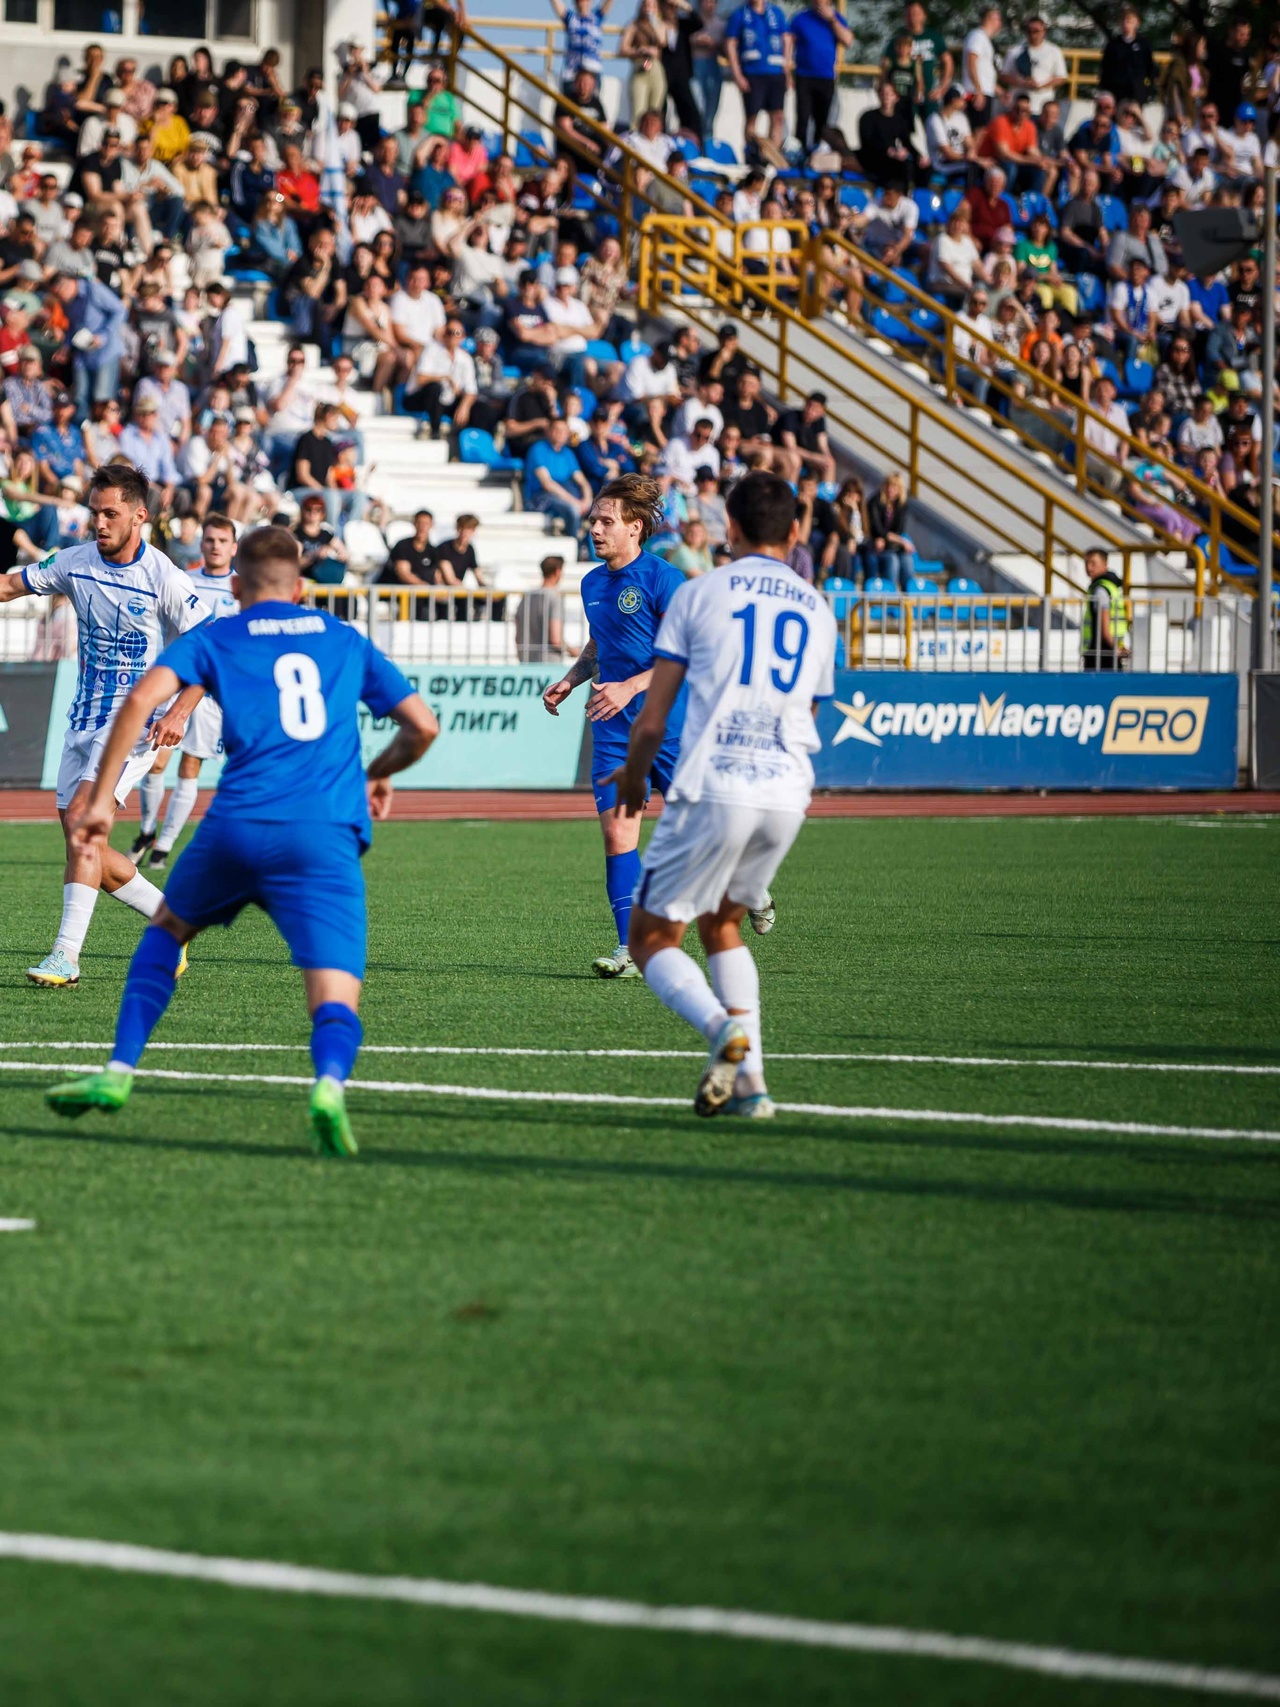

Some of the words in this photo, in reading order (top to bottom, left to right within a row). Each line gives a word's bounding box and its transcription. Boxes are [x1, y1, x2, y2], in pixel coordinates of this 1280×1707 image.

[730, 575, 817, 611] РУДЕНКО
[96, 654, 147, 668] КОМПАНИЙ
[731, 602, 809, 693] 19
[273, 652, 326, 741] 8
[429, 675, 550, 697] ФУТБОЛУ
[449, 711, 518, 732] ЛИГИ
[1111, 709, 1198, 743] PRO
